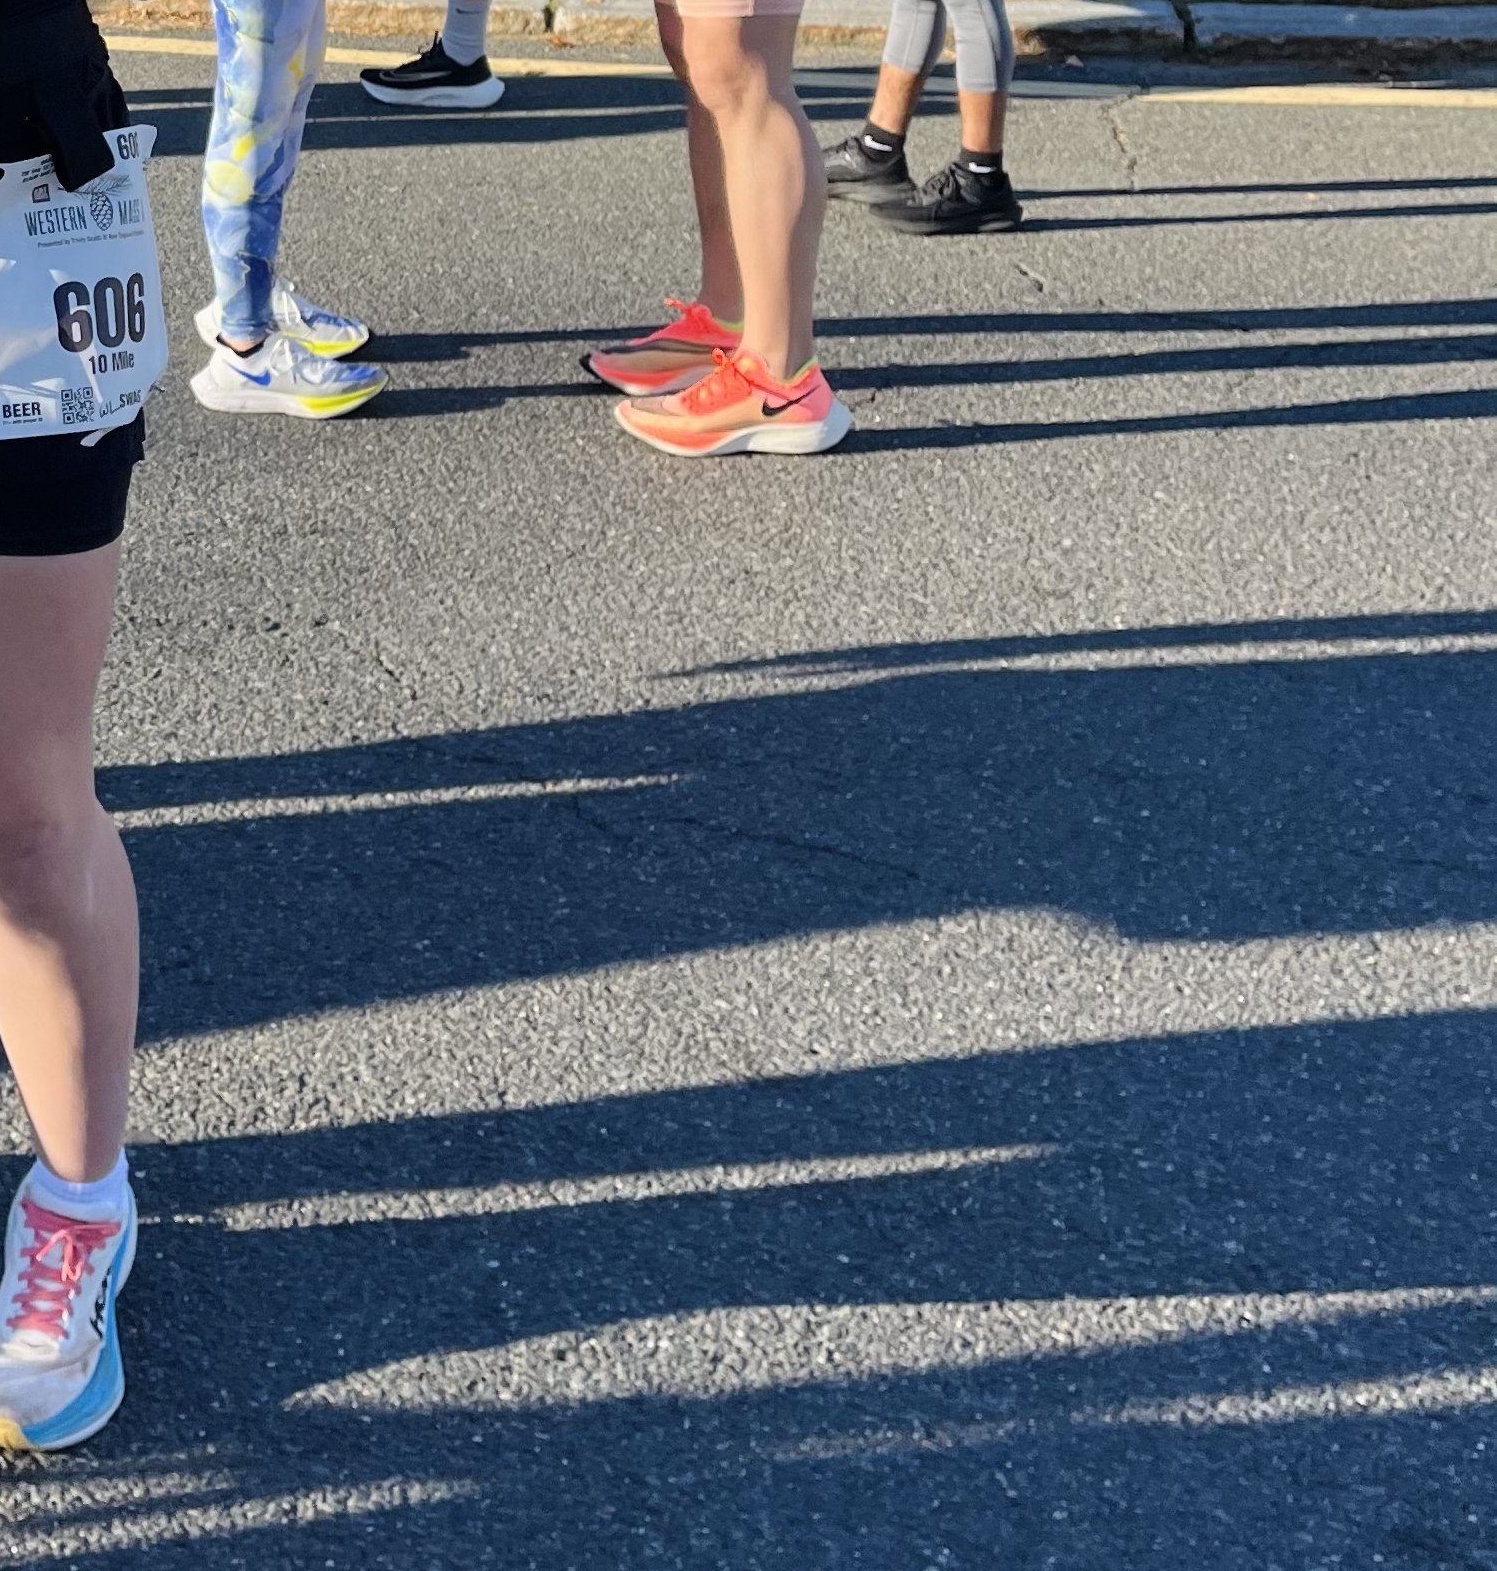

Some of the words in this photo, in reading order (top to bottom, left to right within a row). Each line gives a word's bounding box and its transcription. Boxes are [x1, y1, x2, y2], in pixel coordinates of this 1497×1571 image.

[24, 205, 88, 237] WESTERN
[53, 272, 146, 353] 606
[89, 354, 108, 375] 10
[112, 350, 135, 372] Mile
[2, 401, 42, 419] BEER
